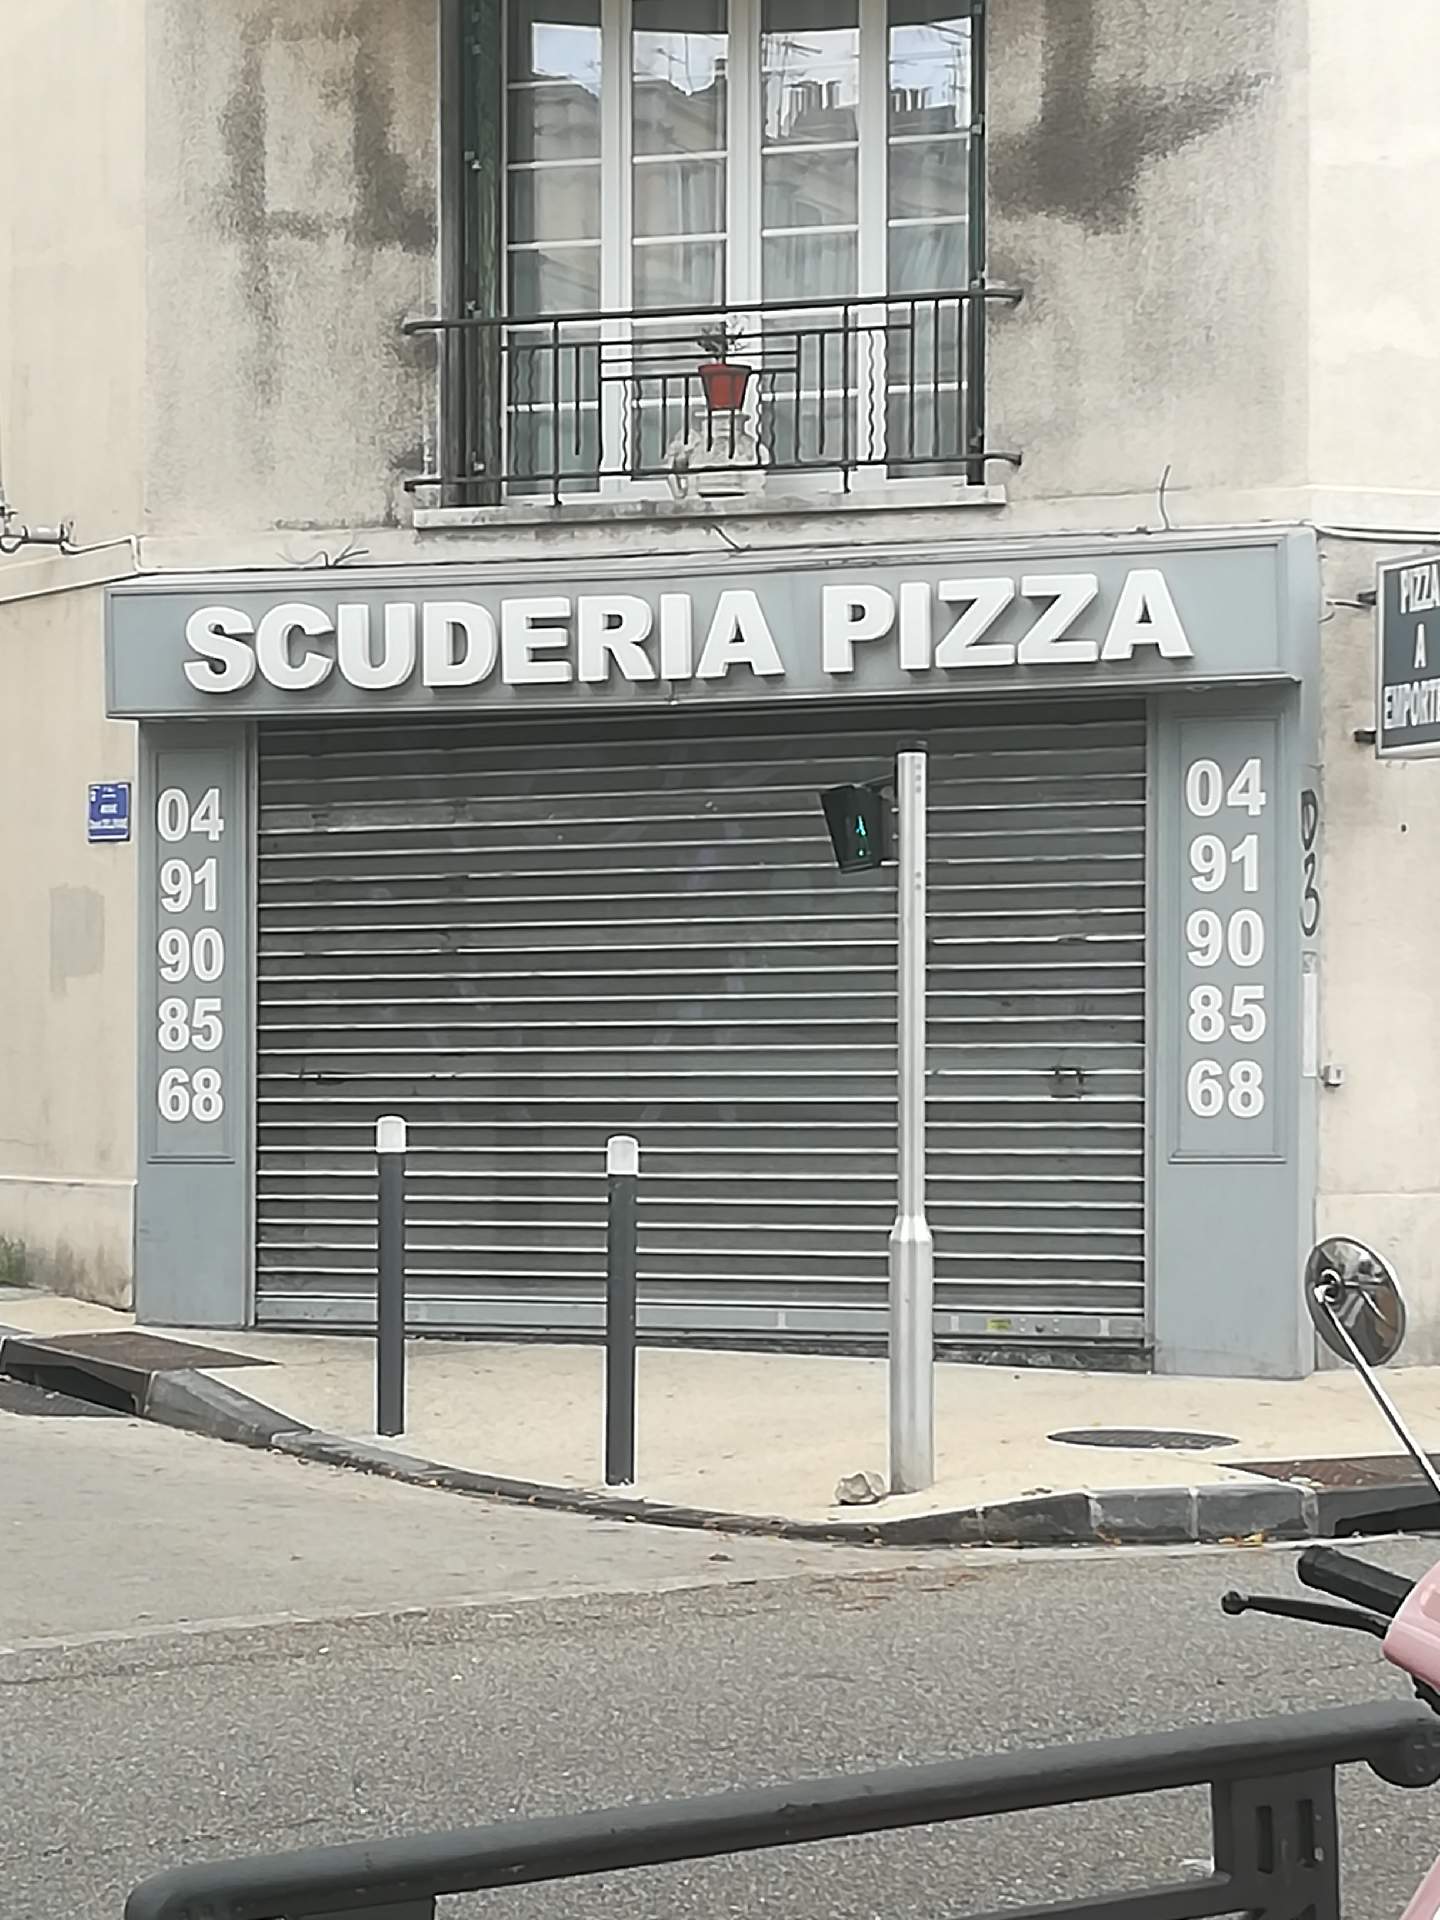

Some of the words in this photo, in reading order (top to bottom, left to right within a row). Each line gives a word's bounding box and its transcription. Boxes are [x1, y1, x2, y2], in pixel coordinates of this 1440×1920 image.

[1400, 563, 1440, 615] PIZZA
[183, 589, 786, 694] SCUDERIA
[821, 568, 1196, 673] PIZZA
[1413, 623, 1427, 669] A
[157, 787, 225, 841] 04
[1186, 758, 1267, 817] 04
[160, 857, 218, 913] 91
[1190, 834, 1259, 893] 91
[158, 928, 225, 982] 90
[1186, 909, 1265, 967] 90
[158, 997, 224, 1051] 85
[1187, 984, 1267, 1043] 85
[158, 1067, 224, 1122] 68
[1186, 1059, 1265, 1118] 68
